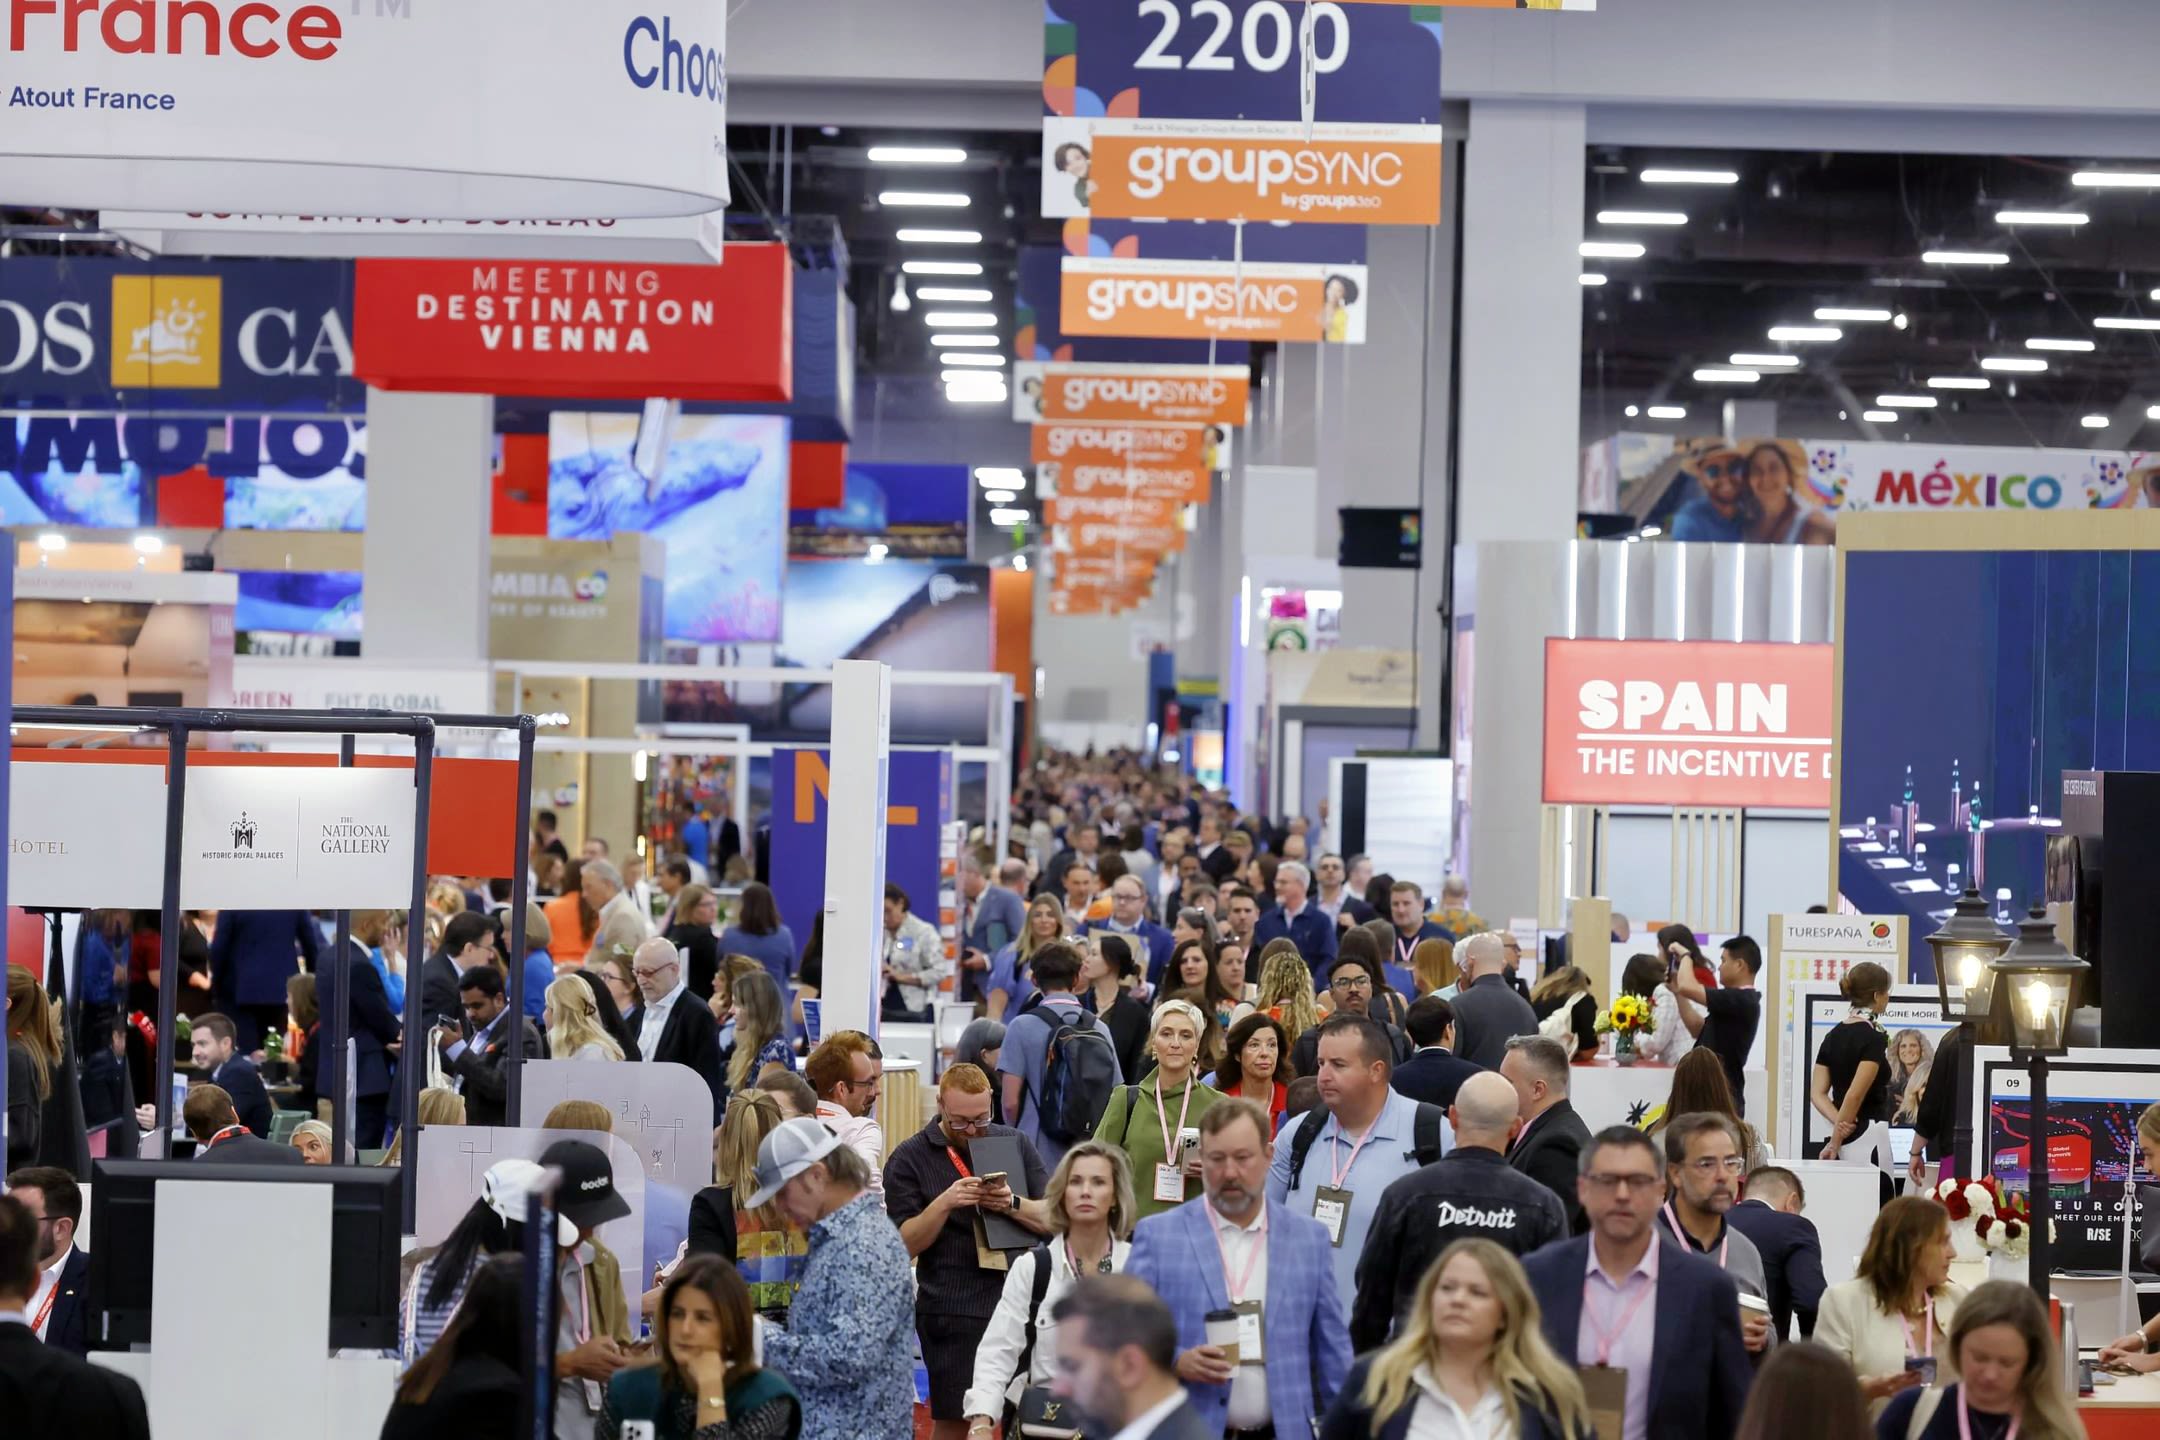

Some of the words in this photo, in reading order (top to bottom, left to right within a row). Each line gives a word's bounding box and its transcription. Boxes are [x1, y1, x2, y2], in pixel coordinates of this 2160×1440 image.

[10, 0, 343, 60] France
[1133, 0, 1349, 74] 2200
[9, 86, 75, 108] Atout
[84, 87, 176, 110] France
[1127, 146, 1403, 199] groupSYNC
[472, 266, 660, 297] MEETING
[416, 293, 715, 325] DESTINATION
[480, 324, 651, 353] VIENNA
[1578, 679, 1788, 733] SPAIN
[1577, 747, 1636, 775] THE
[1647, 748, 1810, 779] INCENTIVE
[322, 824, 391, 838] NATIONAL
[202, 851, 232, 860] HISTORIC
[233, 851, 254, 860] ROYAL
[255, 851, 284, 860] PALACES
[321, 839, 390, 854] GALLERY
[1788, 926, 1863, 939] TURESPAÑA
[1824, 1008, 1834, 1017] 27
[1911, 1010, 1938, 1019] MORE
[2006, 1078, 2020, 1088] 09
[1437, 1200, 1517, 1229] Detroit
[2054, 1213, 2080, 1222] MEET
[2083, 1214, 2104, 1222] OUR
[2086, 1227, 2112, 1241] R/SE
